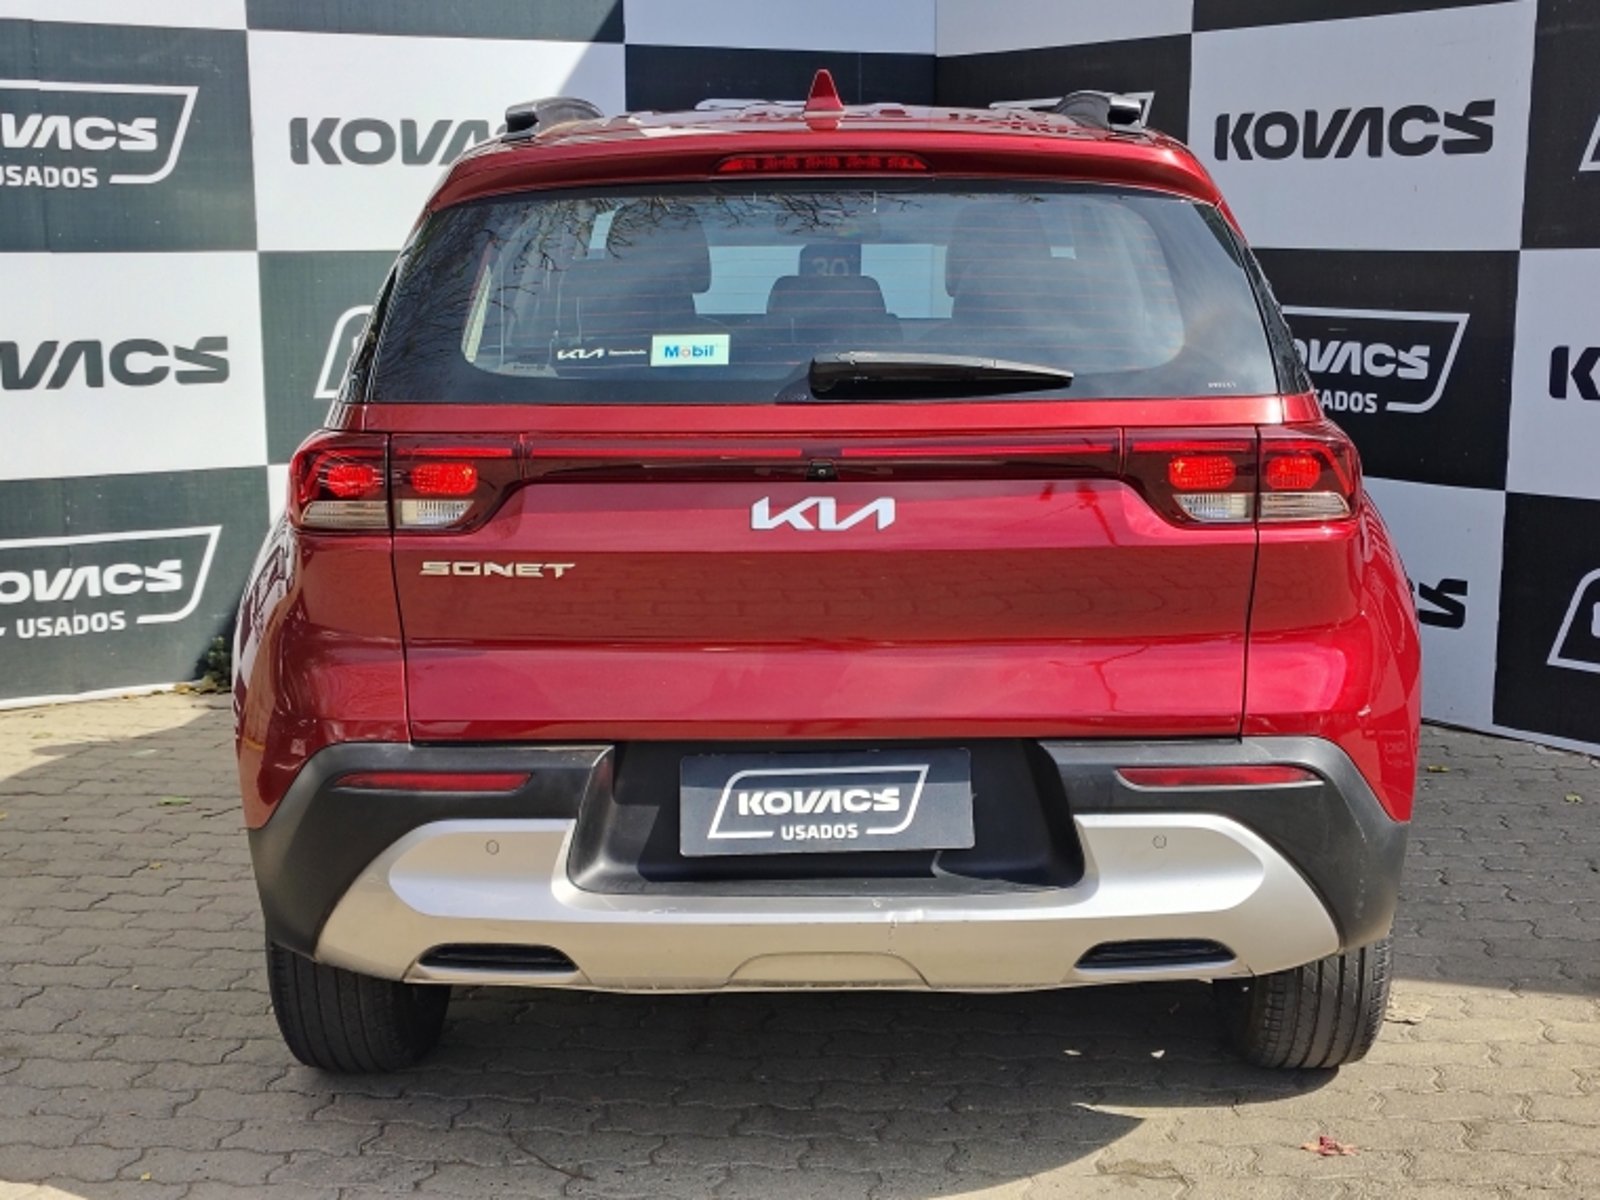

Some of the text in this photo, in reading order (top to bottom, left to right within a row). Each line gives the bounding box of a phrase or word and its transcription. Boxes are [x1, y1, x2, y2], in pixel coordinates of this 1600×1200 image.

[289, 117, 508, 166] KOVA
[1214, 98, 1496, 161] KOVACS
[0, 165, 98, 188] SADOS
[664, 345, 715, 358] Mobil
[1314, 389, 1378, 414] ADOS
[750, 496, 896, 531] KIA
[420, 560, 576, 579] SONET
[16, 610, 127, 640] USADOS
[737, 787, 901, 816] KOVACS
[780, 823, 859, 841] USADOS
